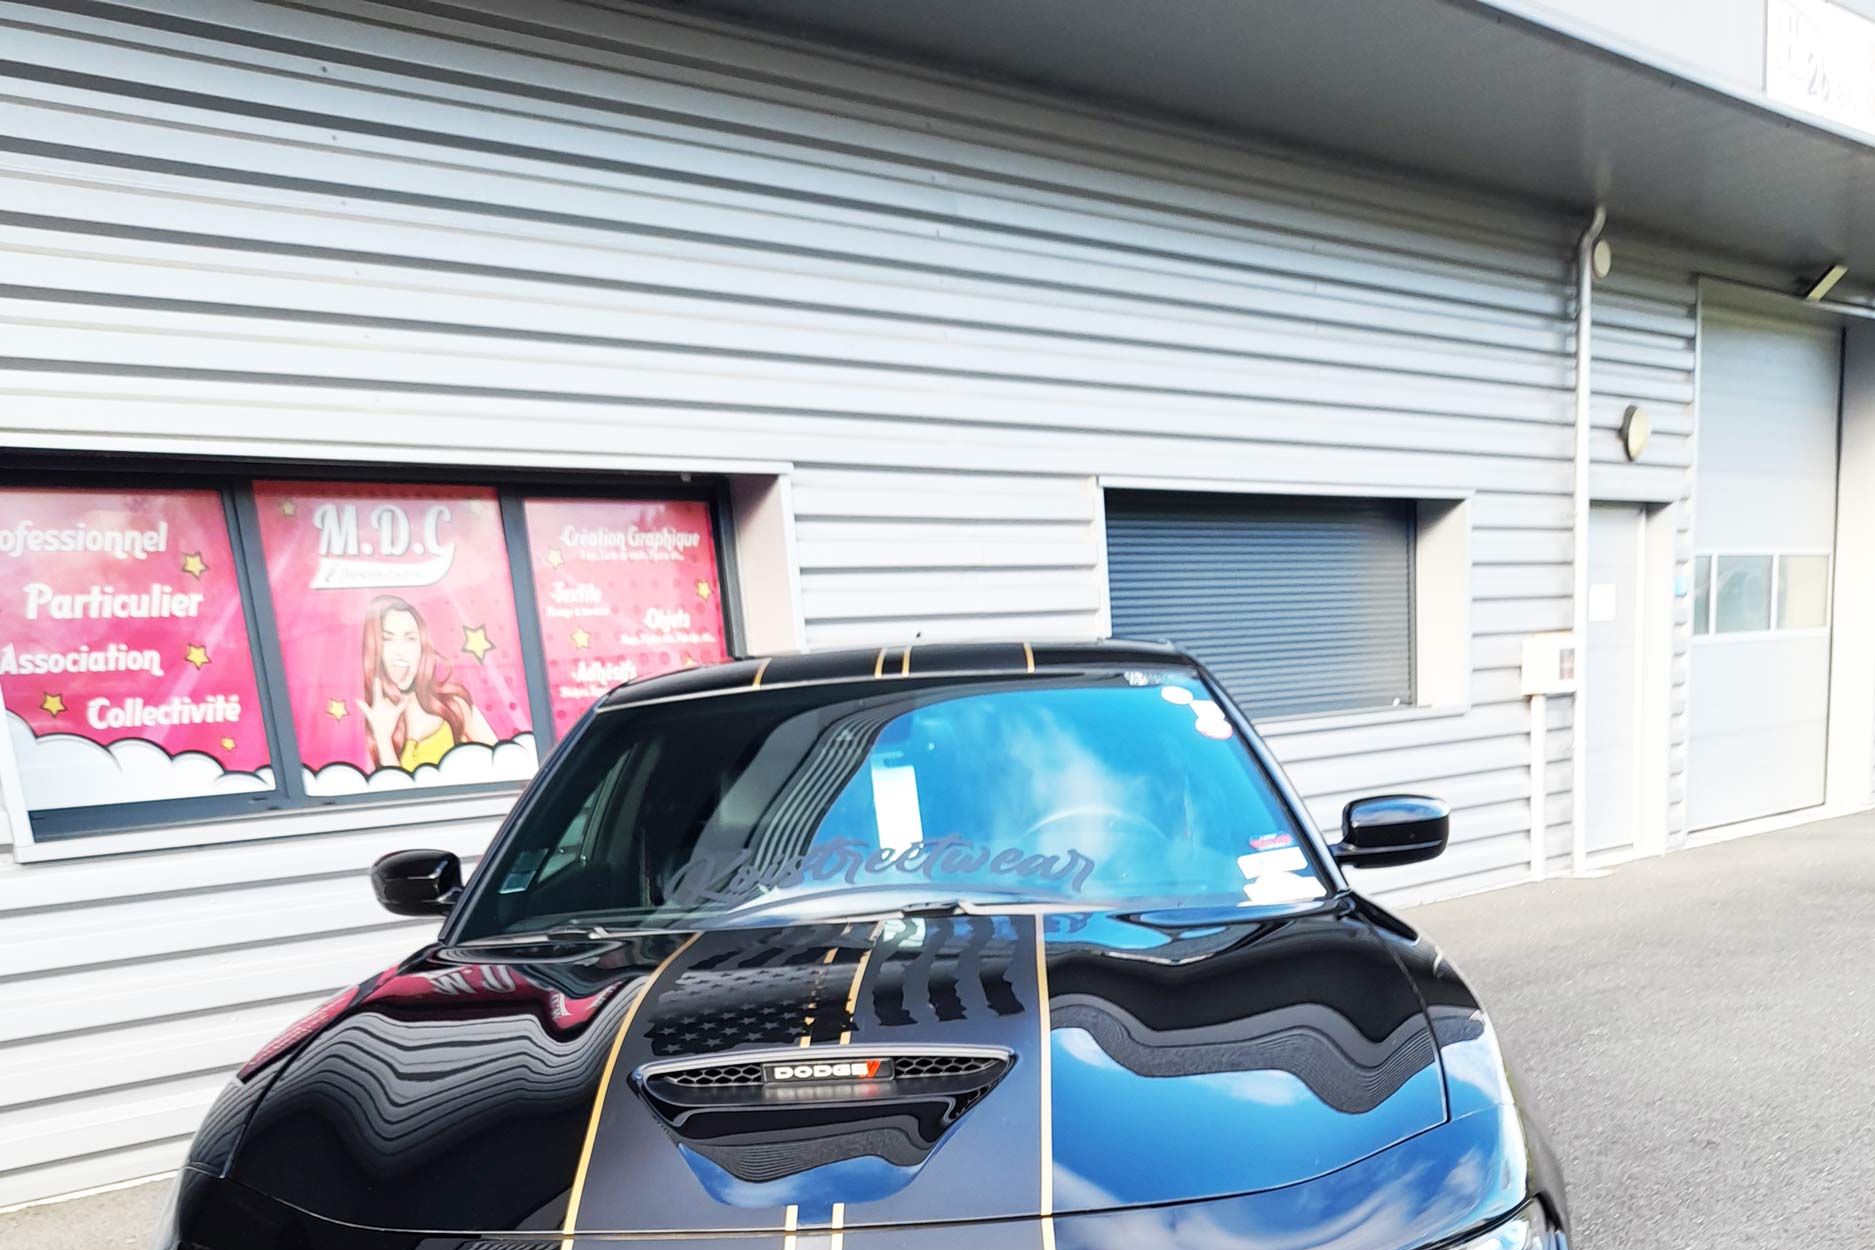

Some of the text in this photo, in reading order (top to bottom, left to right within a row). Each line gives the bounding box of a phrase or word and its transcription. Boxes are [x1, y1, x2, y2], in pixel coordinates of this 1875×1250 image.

[313, 503, 456, 558] M.D.C
[23, 583, 204, 620] Particulier
[0, 642, 165, 677] Association
[86, 694, 242, 730] Collectivité
[774, 1063, 869, 1080] DODGE
